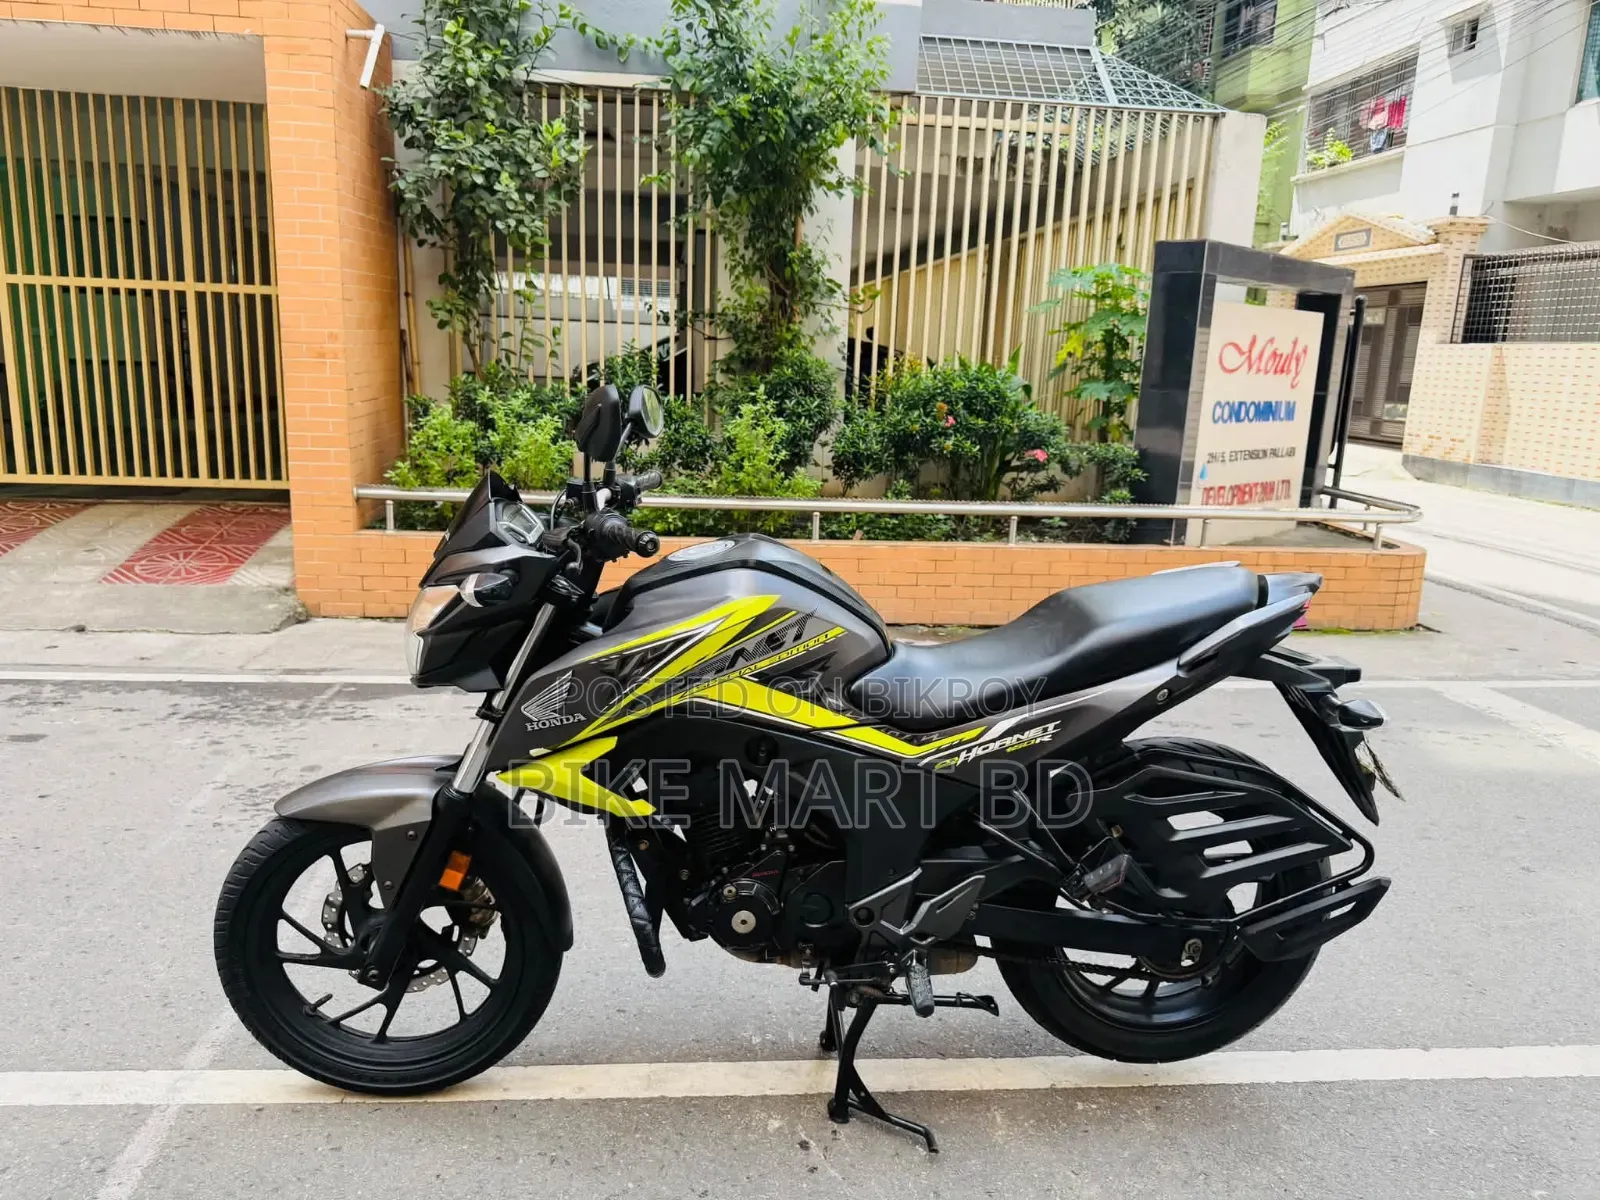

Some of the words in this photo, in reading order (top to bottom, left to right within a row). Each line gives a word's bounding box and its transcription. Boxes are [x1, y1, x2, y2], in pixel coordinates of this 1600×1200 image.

[1212, 401, 1297, 423] CONDOMINIUM
[1229, 449, 1268, 462] EXTENSION
[525, 712, 587, 732] HONDA
[957, 720, 1062, 767] HORNET
